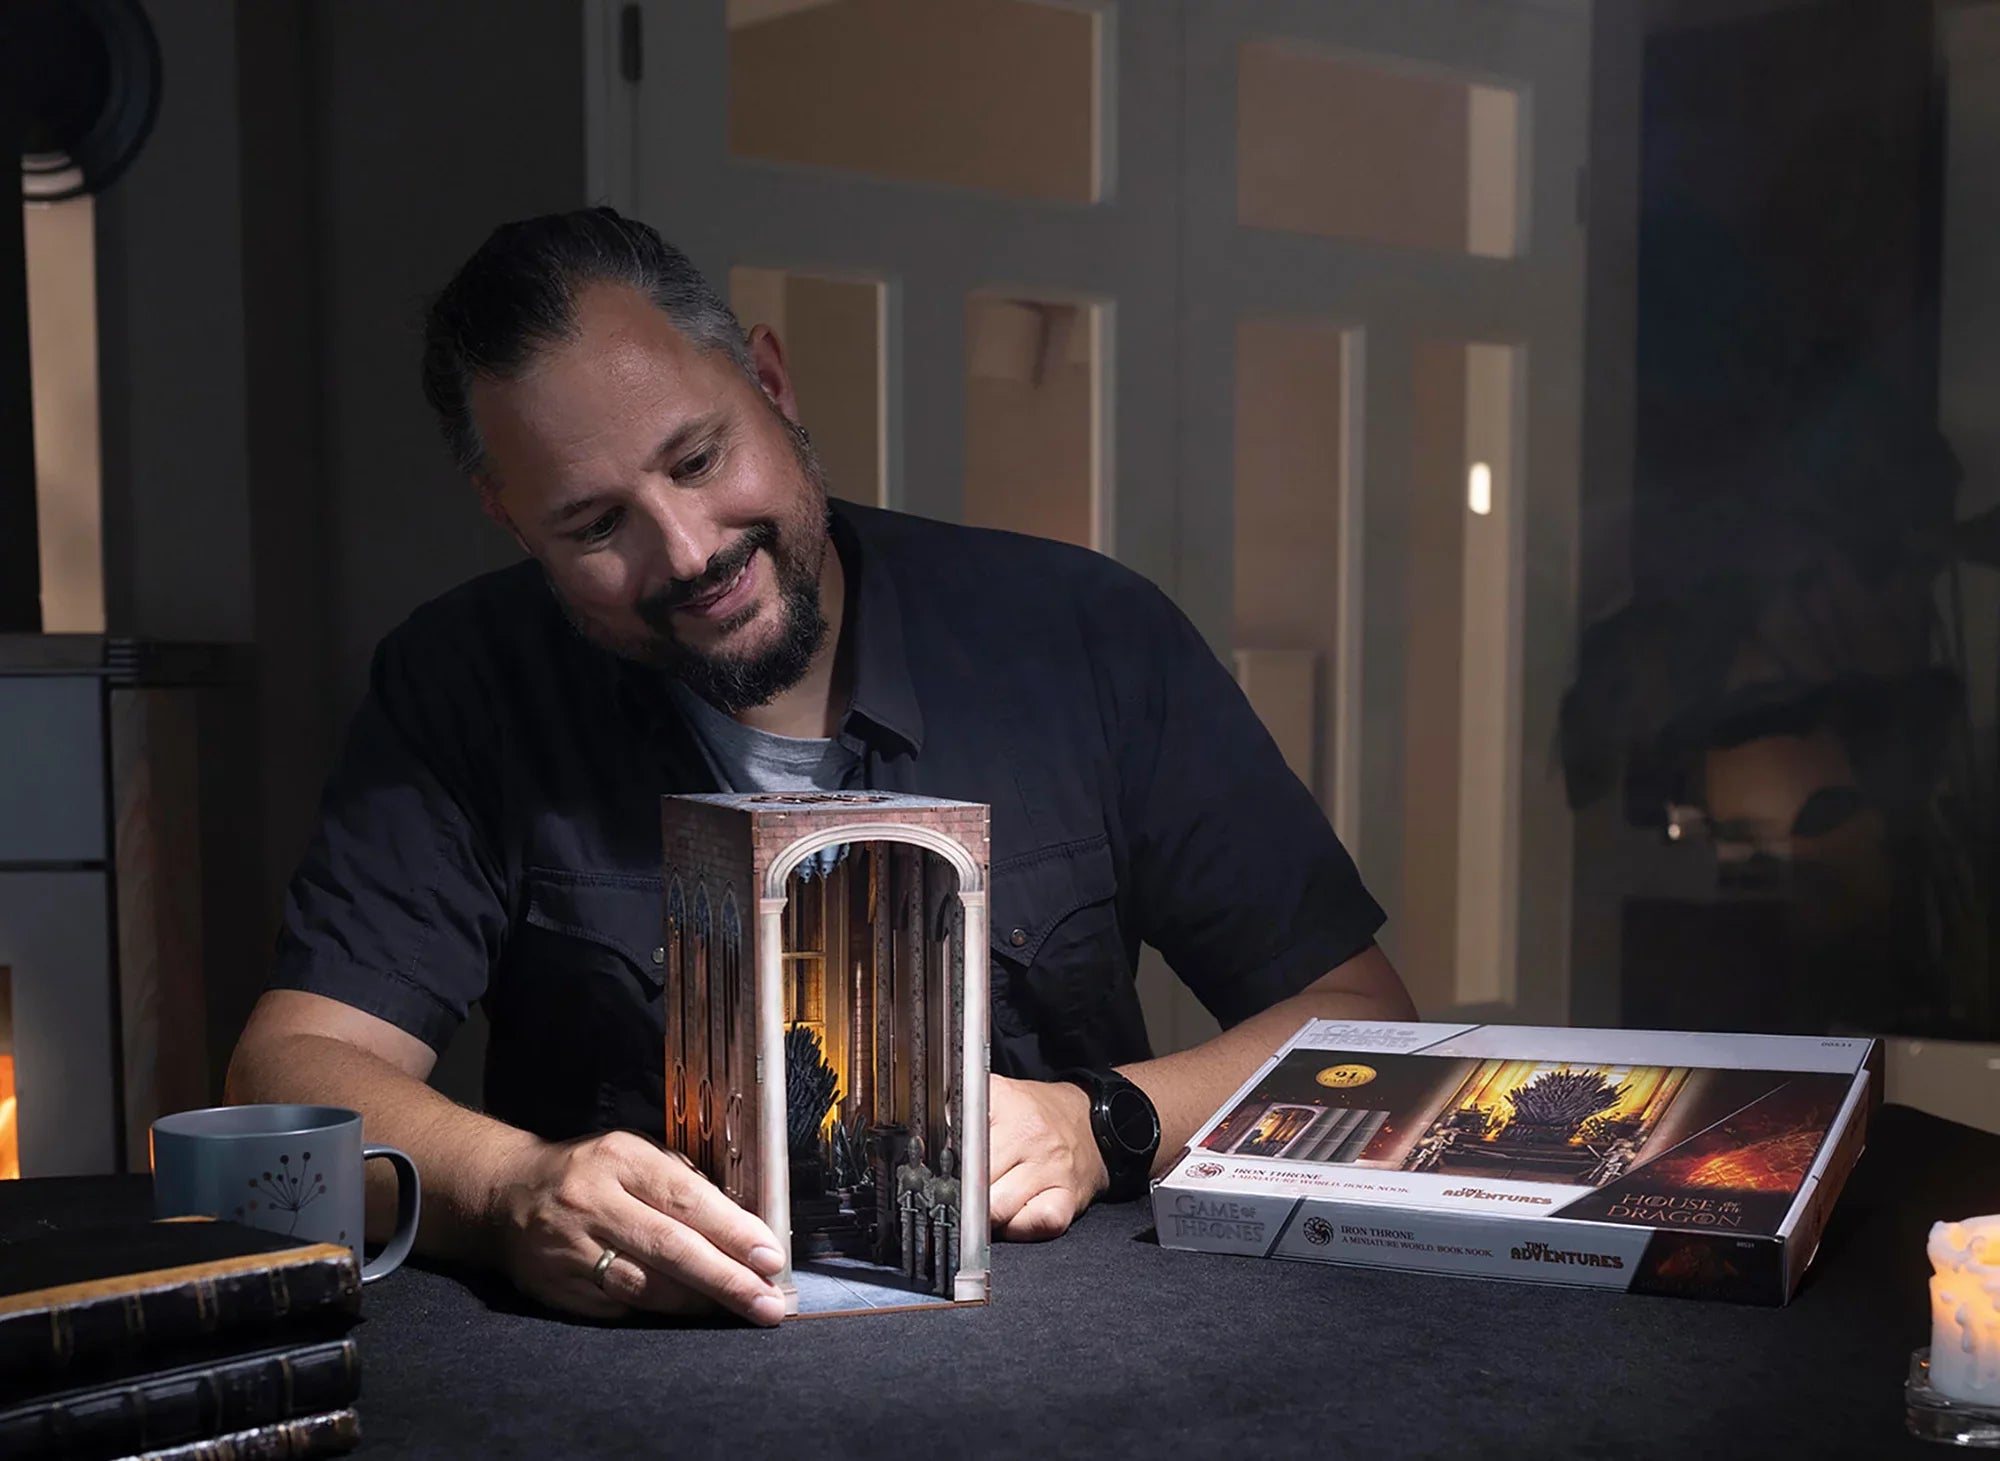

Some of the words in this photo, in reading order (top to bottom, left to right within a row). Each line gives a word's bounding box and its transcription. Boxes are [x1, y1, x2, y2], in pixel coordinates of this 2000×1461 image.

[1270, 1171, 1322, 1180] THRONE
[1442, 1189, 1553, 1205] ADVENTURES
[1621, 1193, 1715, 1211] HOUSE
[1175, 1195, 1239, 1218] GAME
[1607, 1205, 1742, 1227] DRAGON
[1168, 1214, 1264, 1242] THRONES
[1341, 1225, 1367, 1236] IRON
[1370, 1228, 1415, 1240] THRONE
[1350, 1237, 1400, 1249] MINIATURE
[1437, 1246, 1464, 1255] BOOK
[1525, 1241, 1549, 1250] TINY
[1511, 1247, 1624, 1269] ADVENTURES
